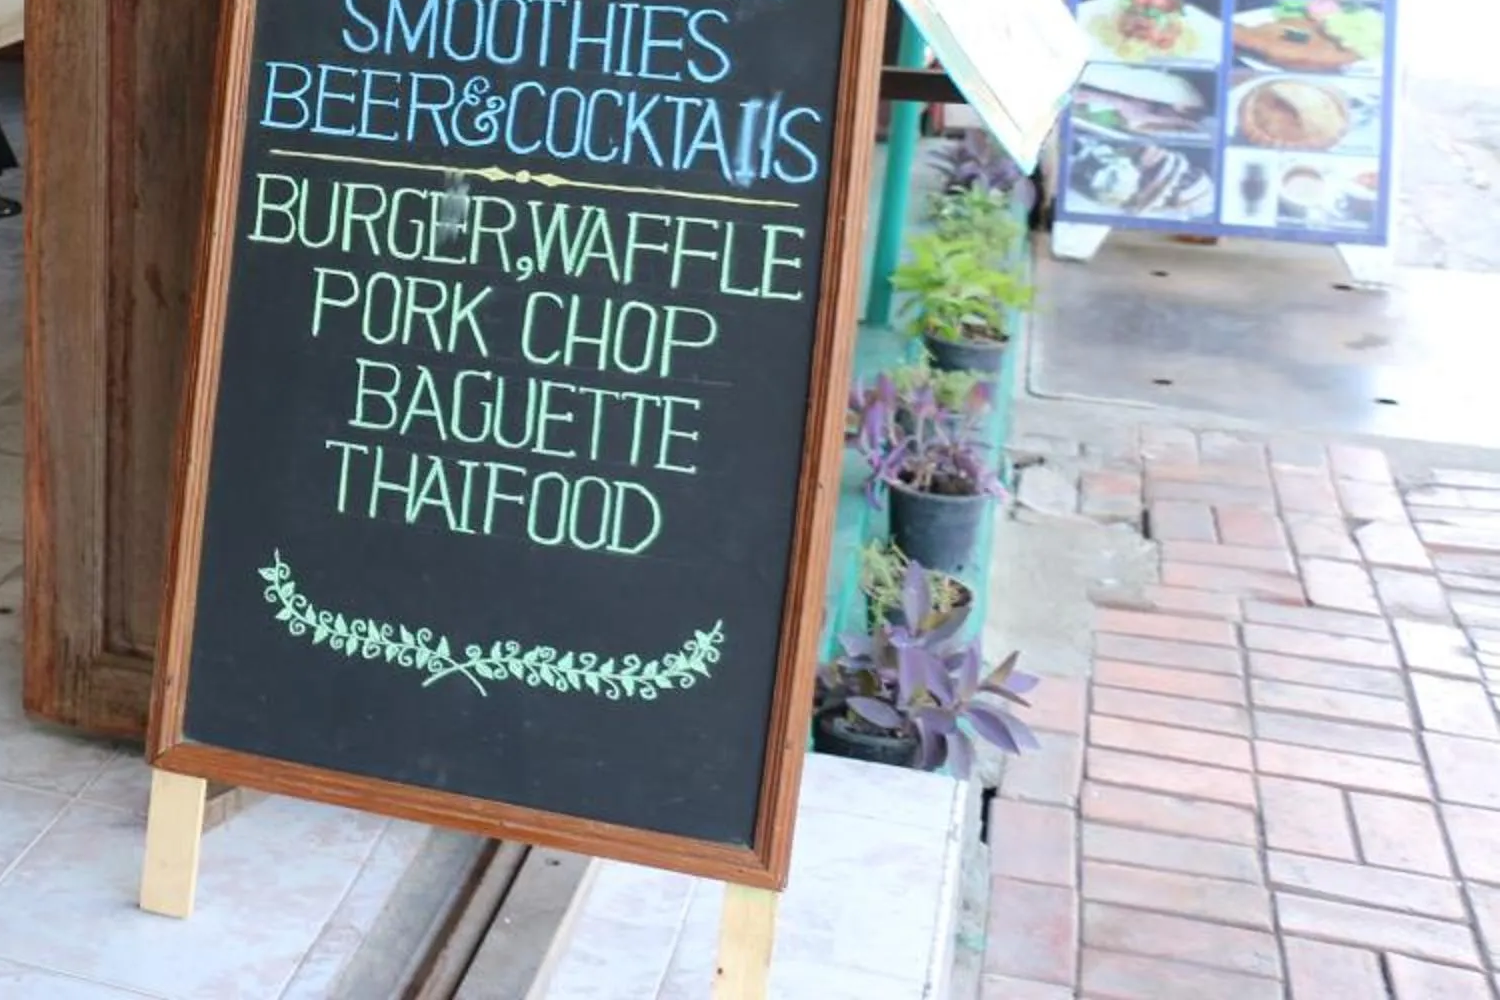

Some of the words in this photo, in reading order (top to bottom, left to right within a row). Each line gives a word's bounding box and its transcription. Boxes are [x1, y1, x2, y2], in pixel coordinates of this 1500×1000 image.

[311, 266, 493, 358] PORK
[521, 291, 718, 378] CHOP
[348, 357, 701, 475] BAGUETTE
